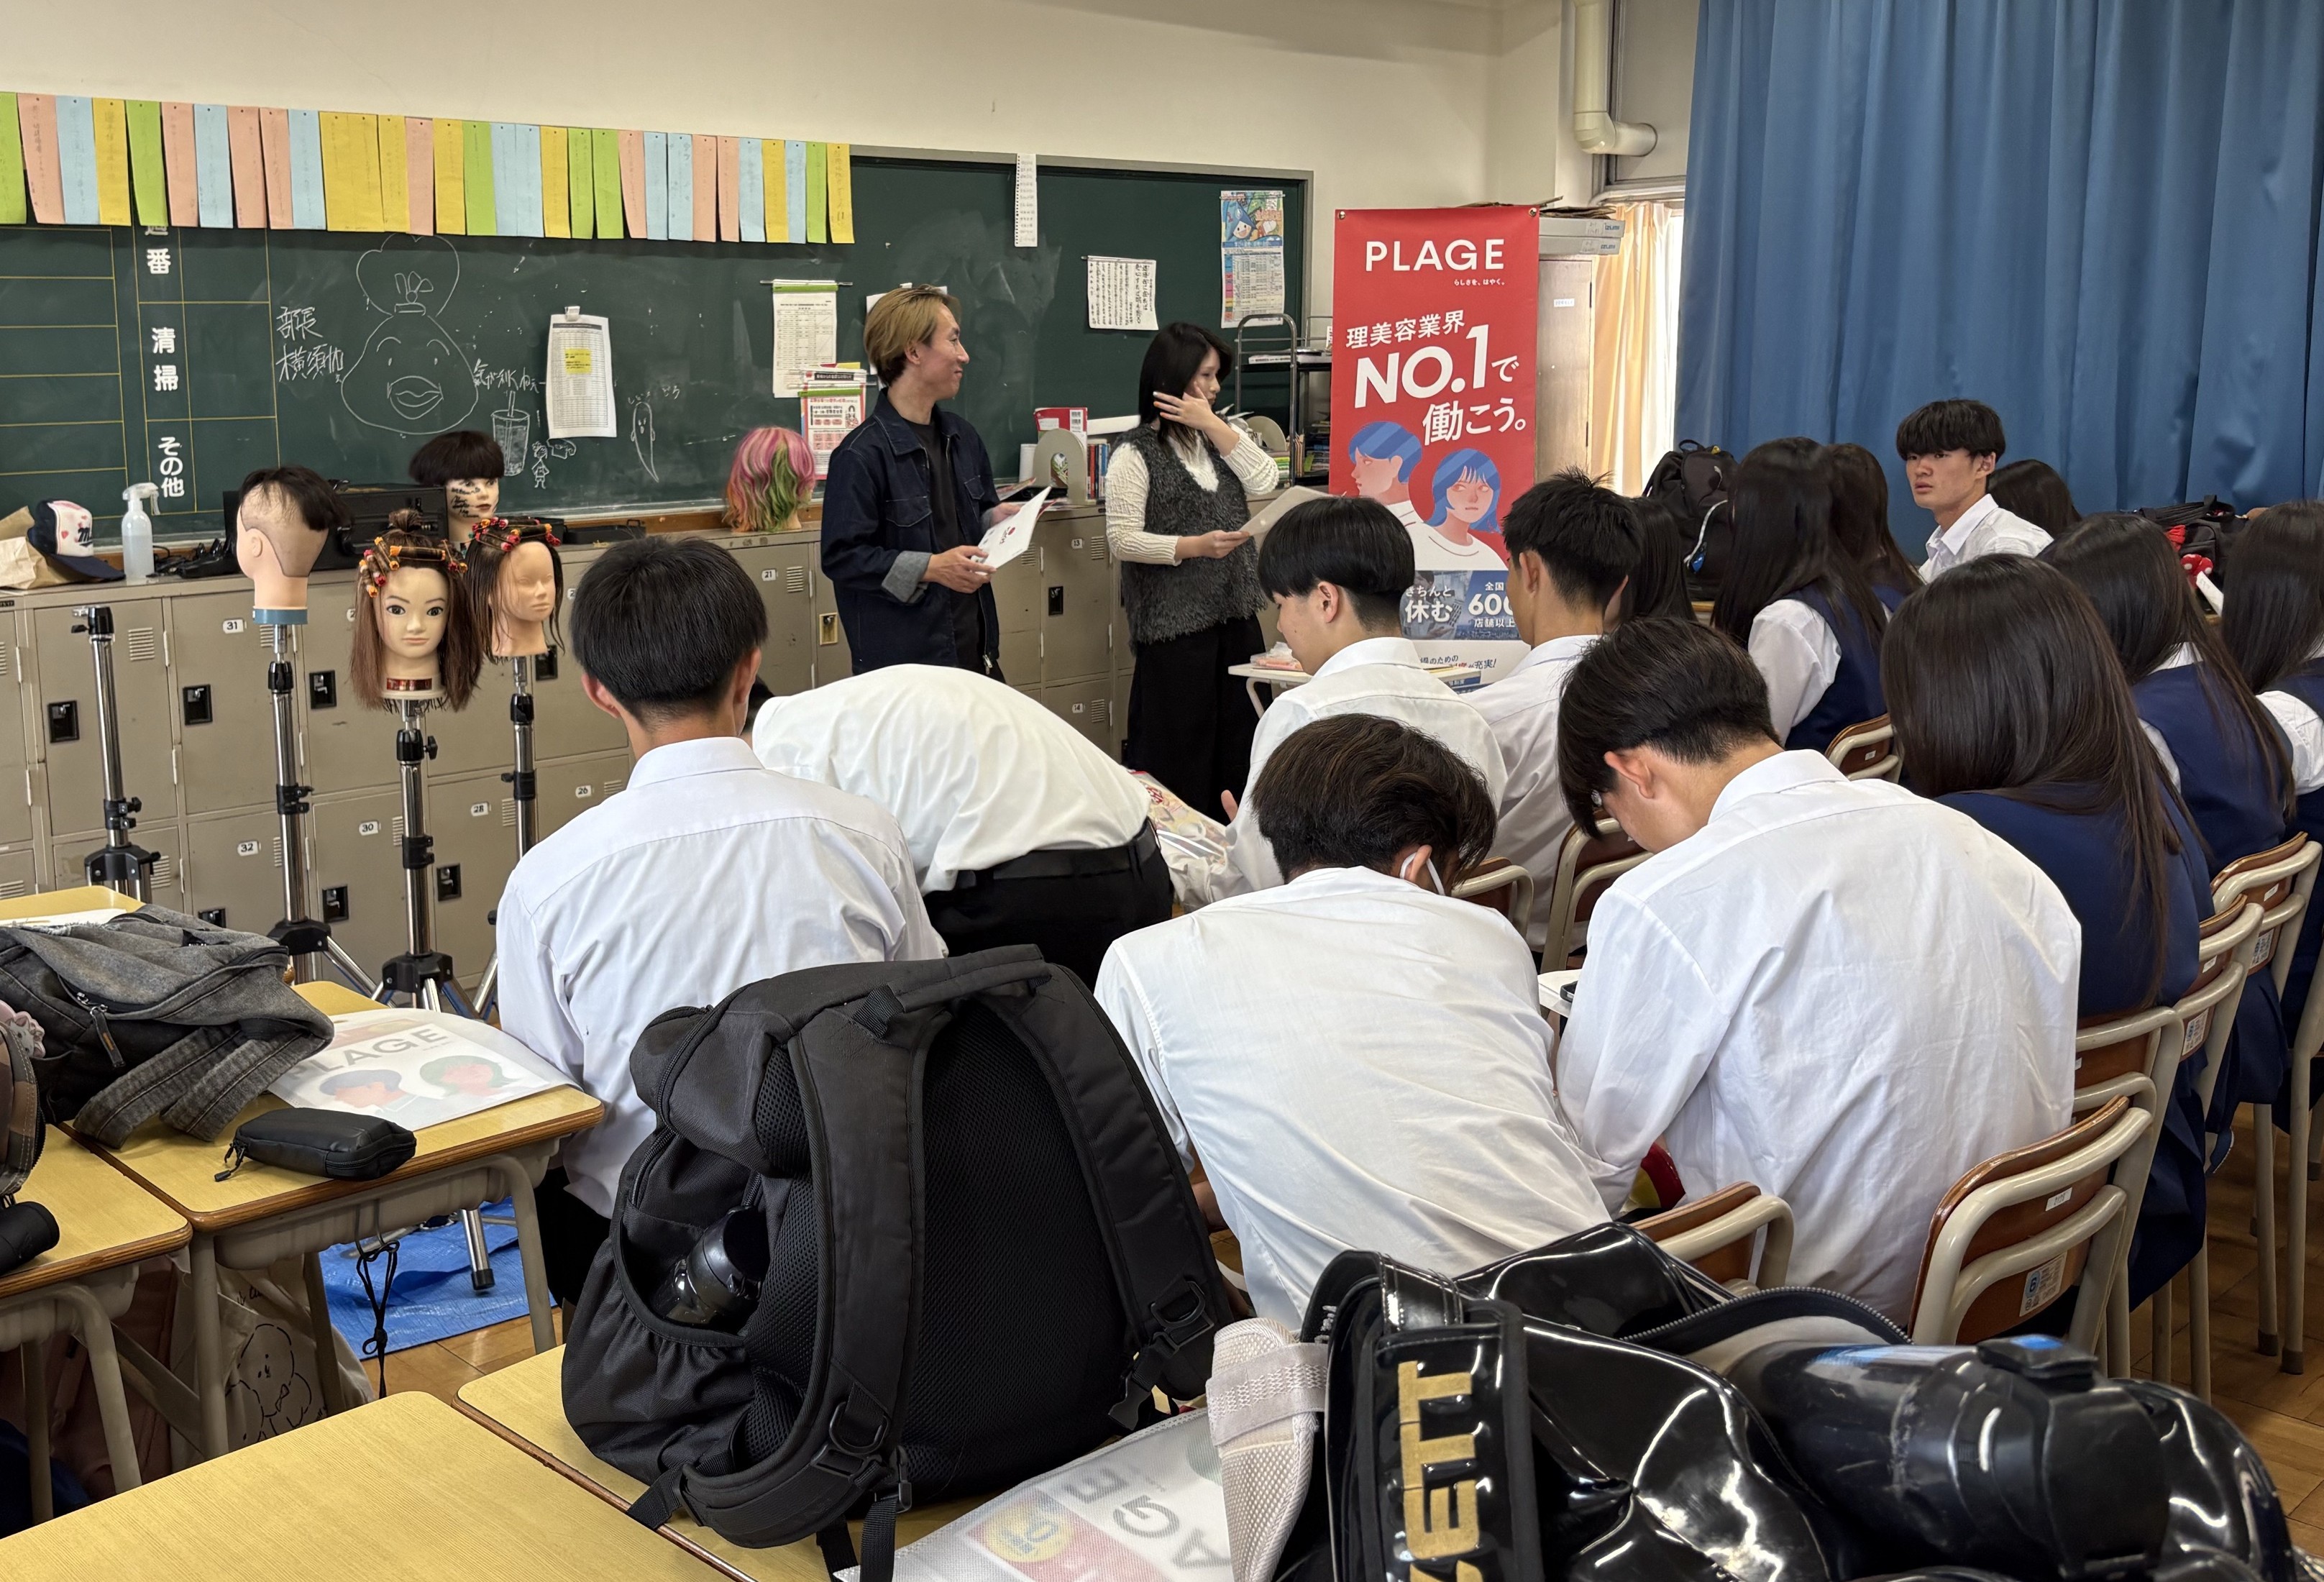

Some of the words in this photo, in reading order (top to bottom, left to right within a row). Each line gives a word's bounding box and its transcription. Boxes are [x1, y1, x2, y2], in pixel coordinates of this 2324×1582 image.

[1365, 239, 1504, 271] PLAGE
[276, 306, 324, 341] 部長
[1345, 309, 1465, 349] 理美容業界
[152, 326, 179, 391] 清掃
[1422, 397, 1527, 446] 働こう。
[157, 436, 185, 498] その他
[1405, 585, 1452, 598] きちんと
[1485, 582, 1504, 591] 全国
[1404, 600, 1453, 623] 休む
[1474, 618, 1516, 628] 店舗以上
[227, 621, 237, 630] 31
[577, 787, 588, 795] 26
[473, 805, 484, 813] 28
[362, 823, 374, 833] 30
[241, 843, 254, 852] 32
[1398, 1360, 1484, 1582] ETT
[1064, 1467, 1232, 1570] AGE
